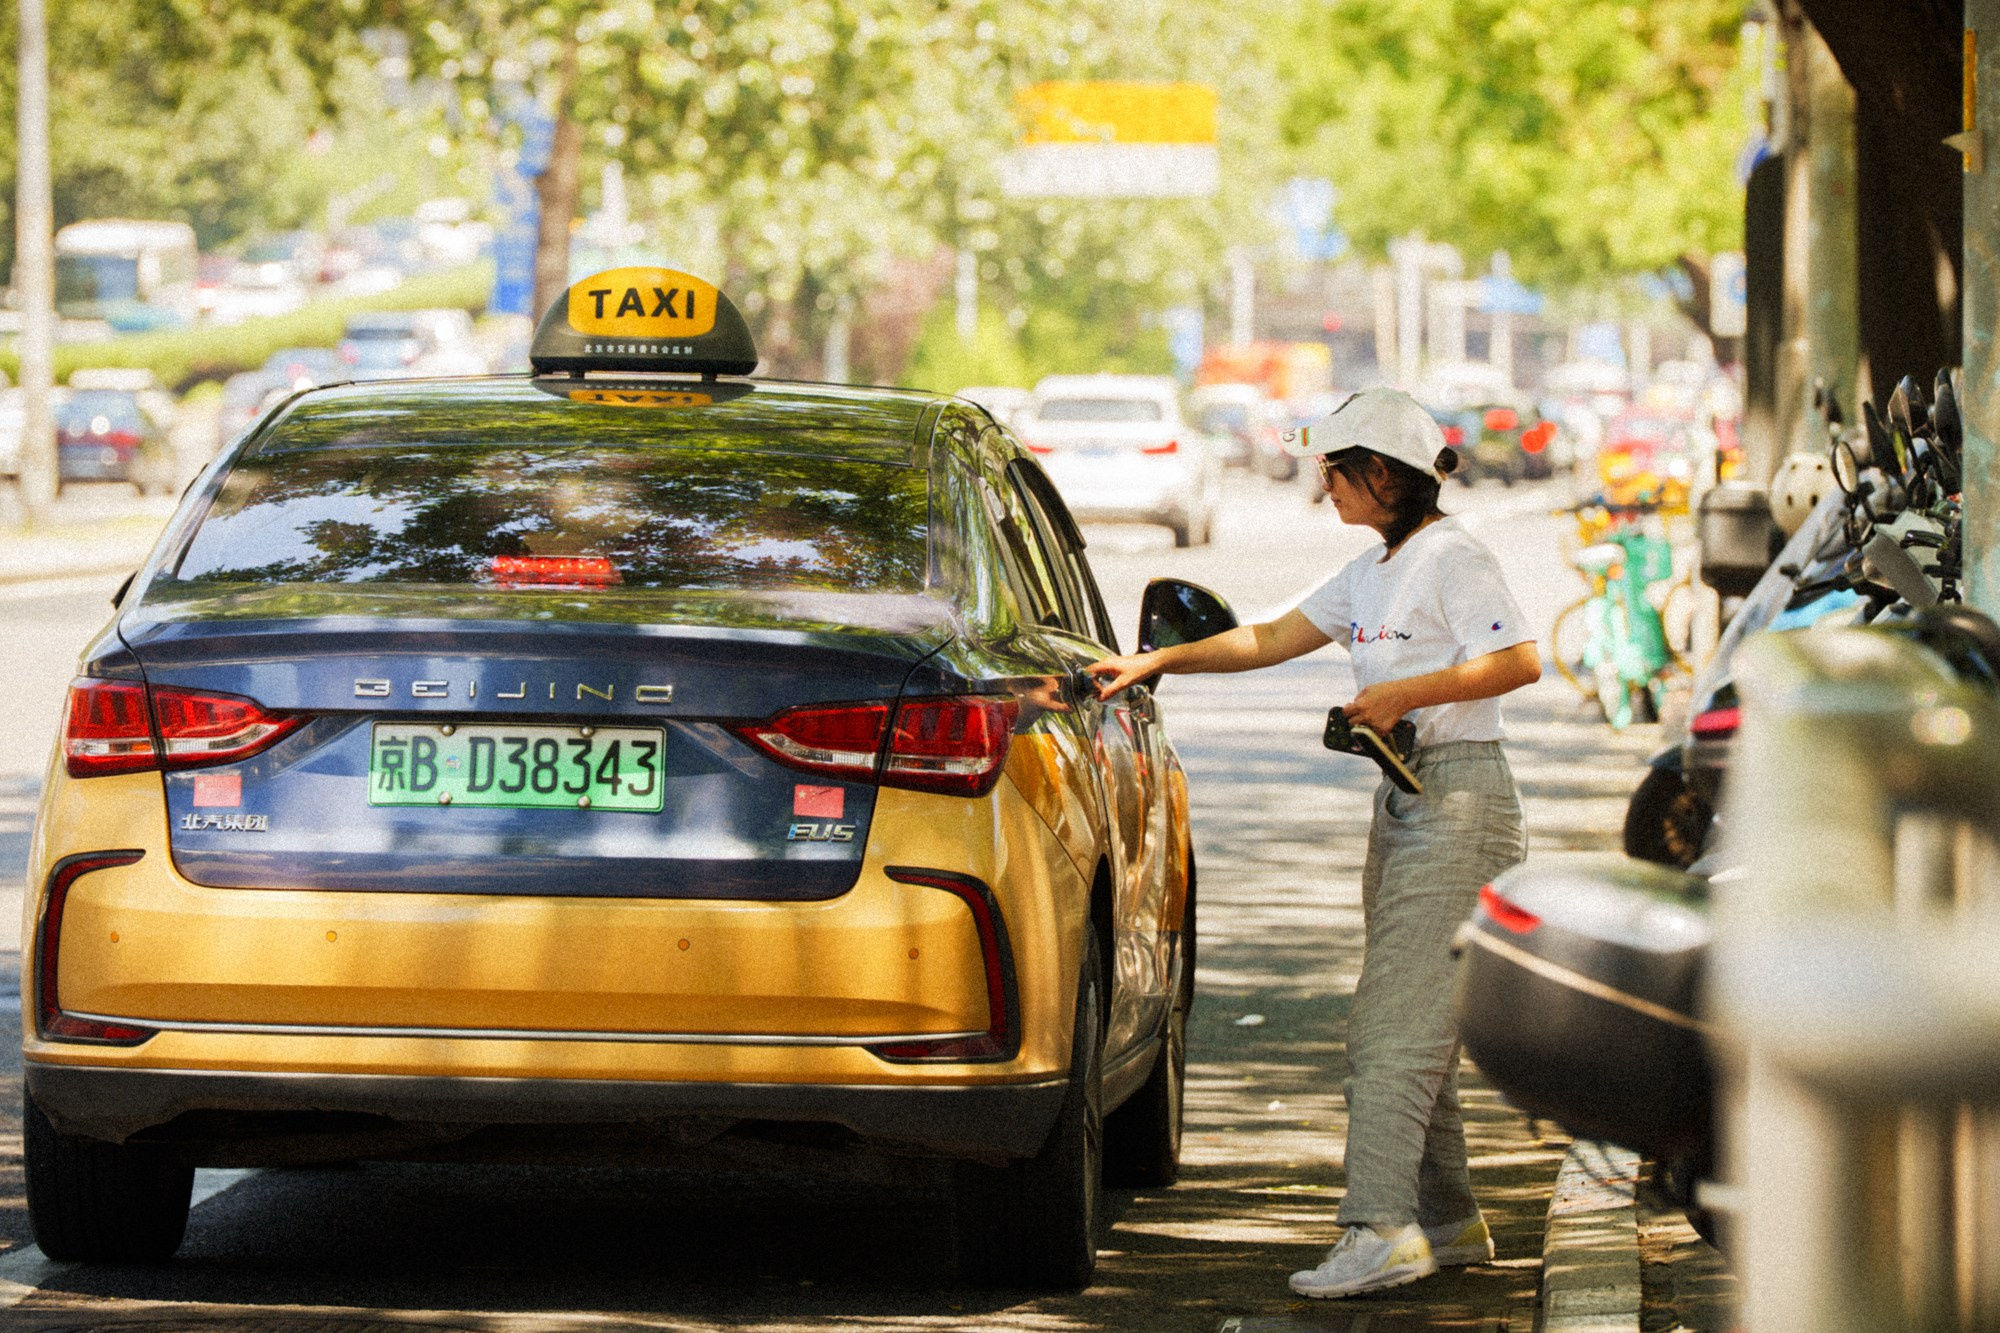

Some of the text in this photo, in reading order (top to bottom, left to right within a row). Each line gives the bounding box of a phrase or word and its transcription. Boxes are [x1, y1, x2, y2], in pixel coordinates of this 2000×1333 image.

[588, 287, 695, 319] TAXI
[354, 679, 673, 703] BEIJING
[181, 813, 269, 832] 北汽集团
[787, 823, 856, 842] EU5
